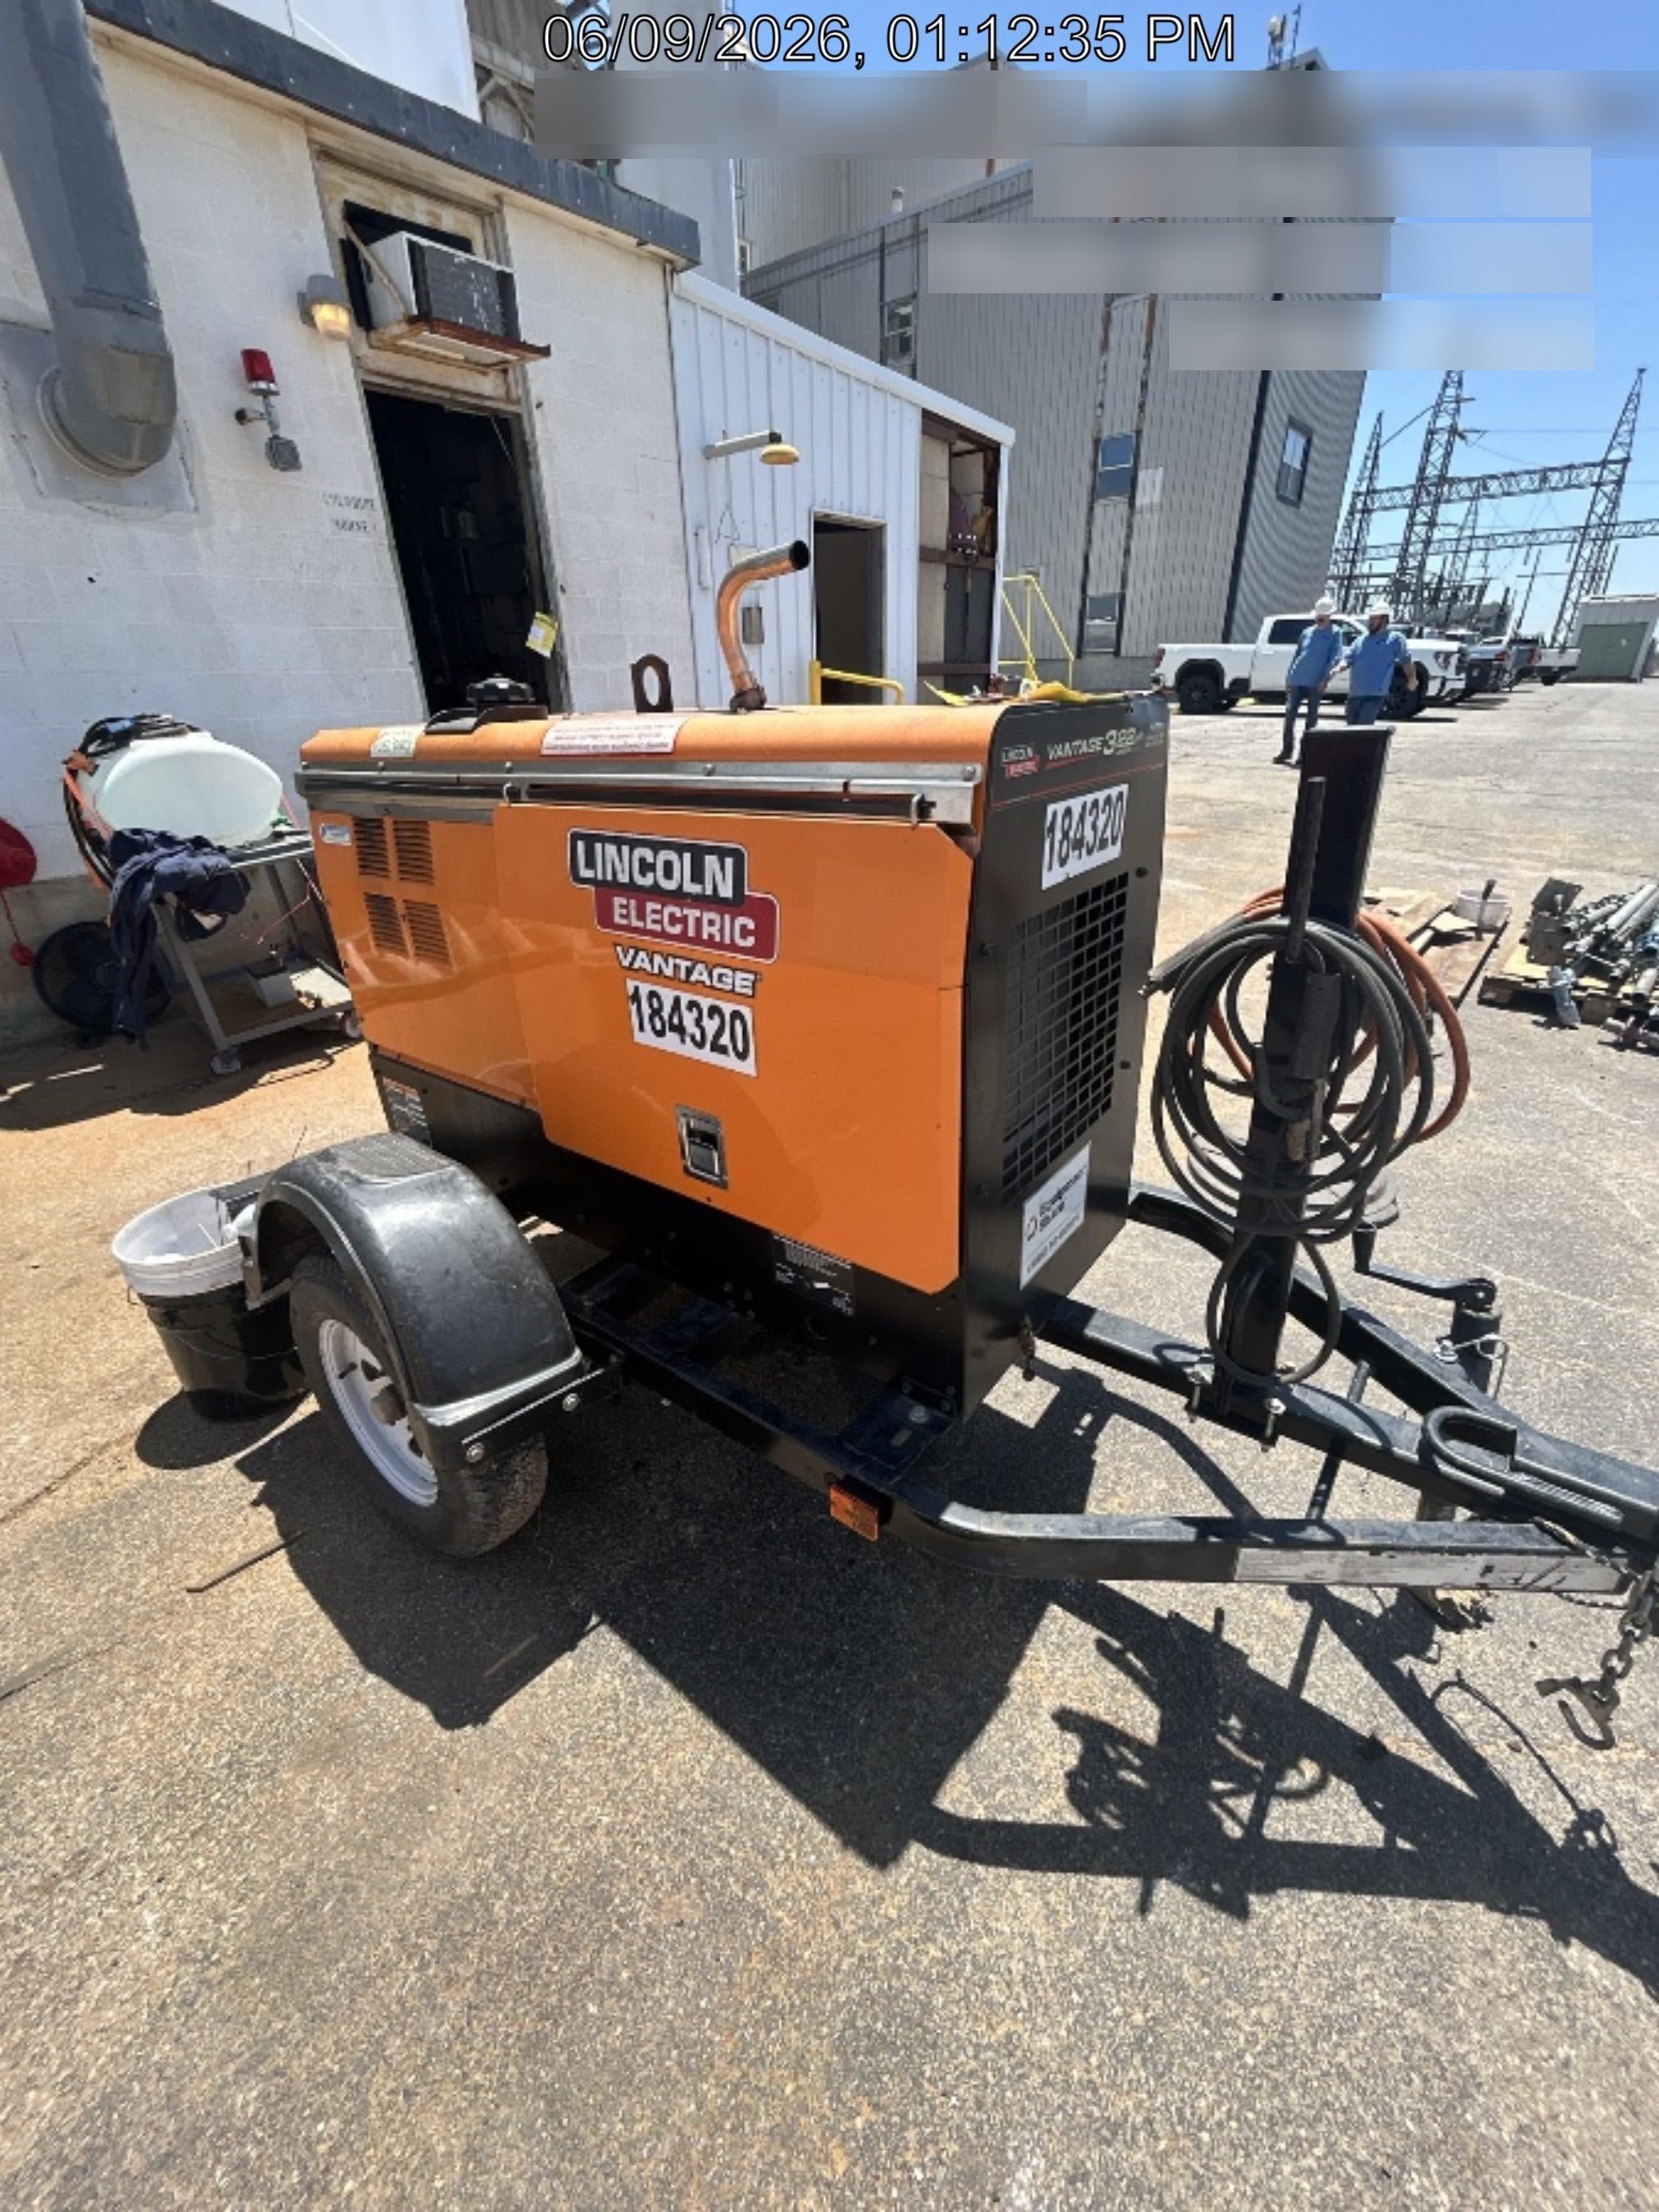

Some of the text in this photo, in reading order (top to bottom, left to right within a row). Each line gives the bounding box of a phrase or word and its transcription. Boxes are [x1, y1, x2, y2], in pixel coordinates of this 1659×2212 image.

[1046, 791, 1124, 873] 184320
[576, 840, 734, 899] LINCOLN
[612, 896, 756, 948] ELECTRIC
[614, 945, 756, 998] VANTAGE
[629, 986, 751, 1062] 184320
